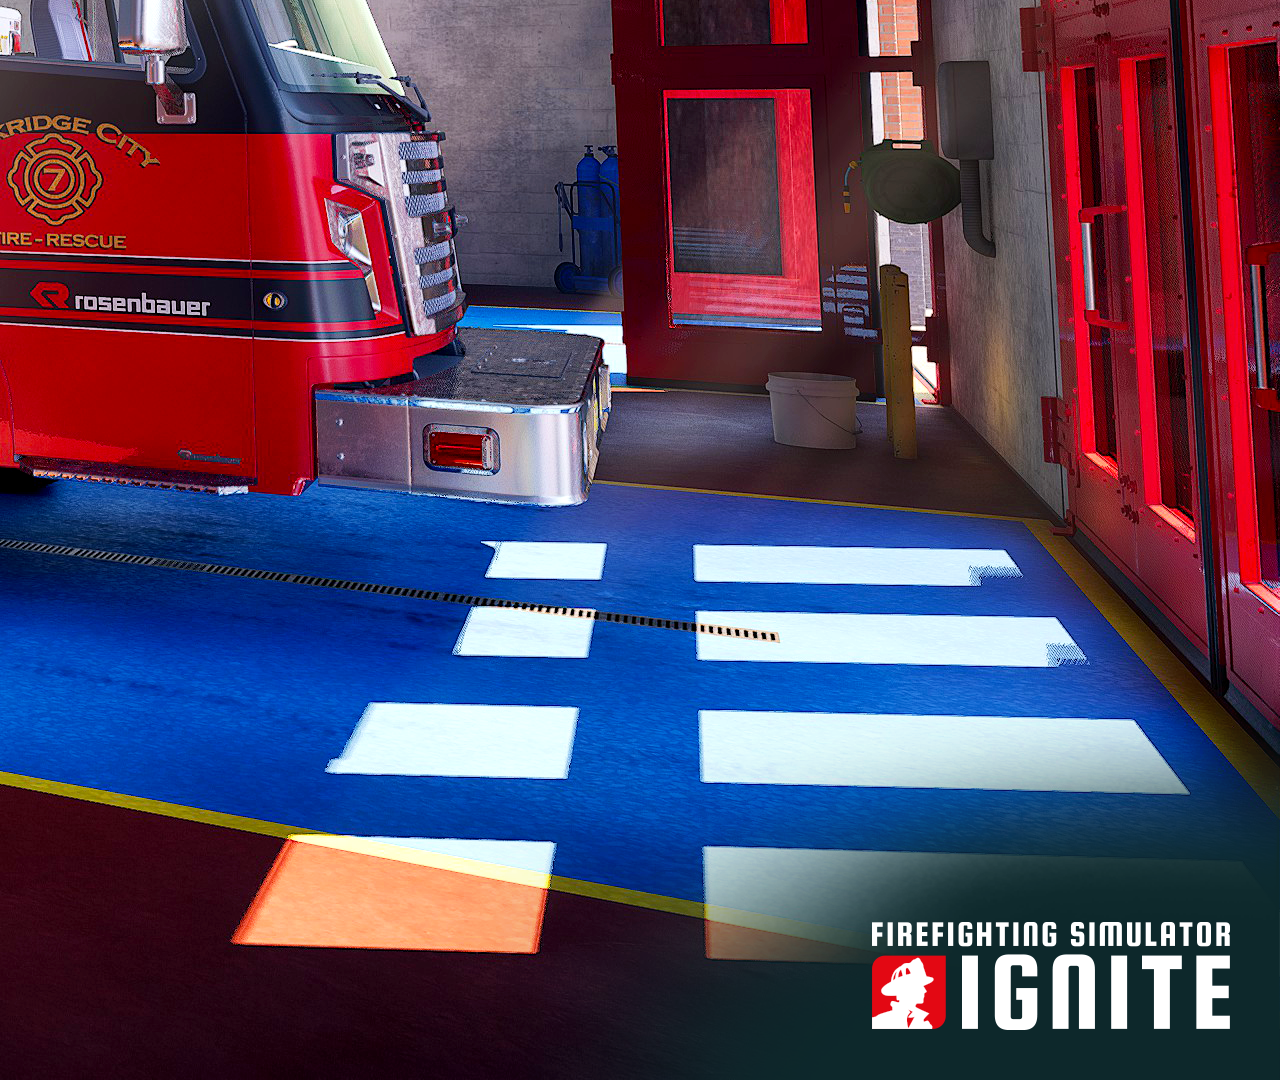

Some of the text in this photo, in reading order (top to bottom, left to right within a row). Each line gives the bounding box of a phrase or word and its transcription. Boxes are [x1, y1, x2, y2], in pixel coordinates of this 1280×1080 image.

[96, 122, 161, 169] CITY
[42, 167, 66, 192] 7
[74, 291, 212, 317] rosenbauer
